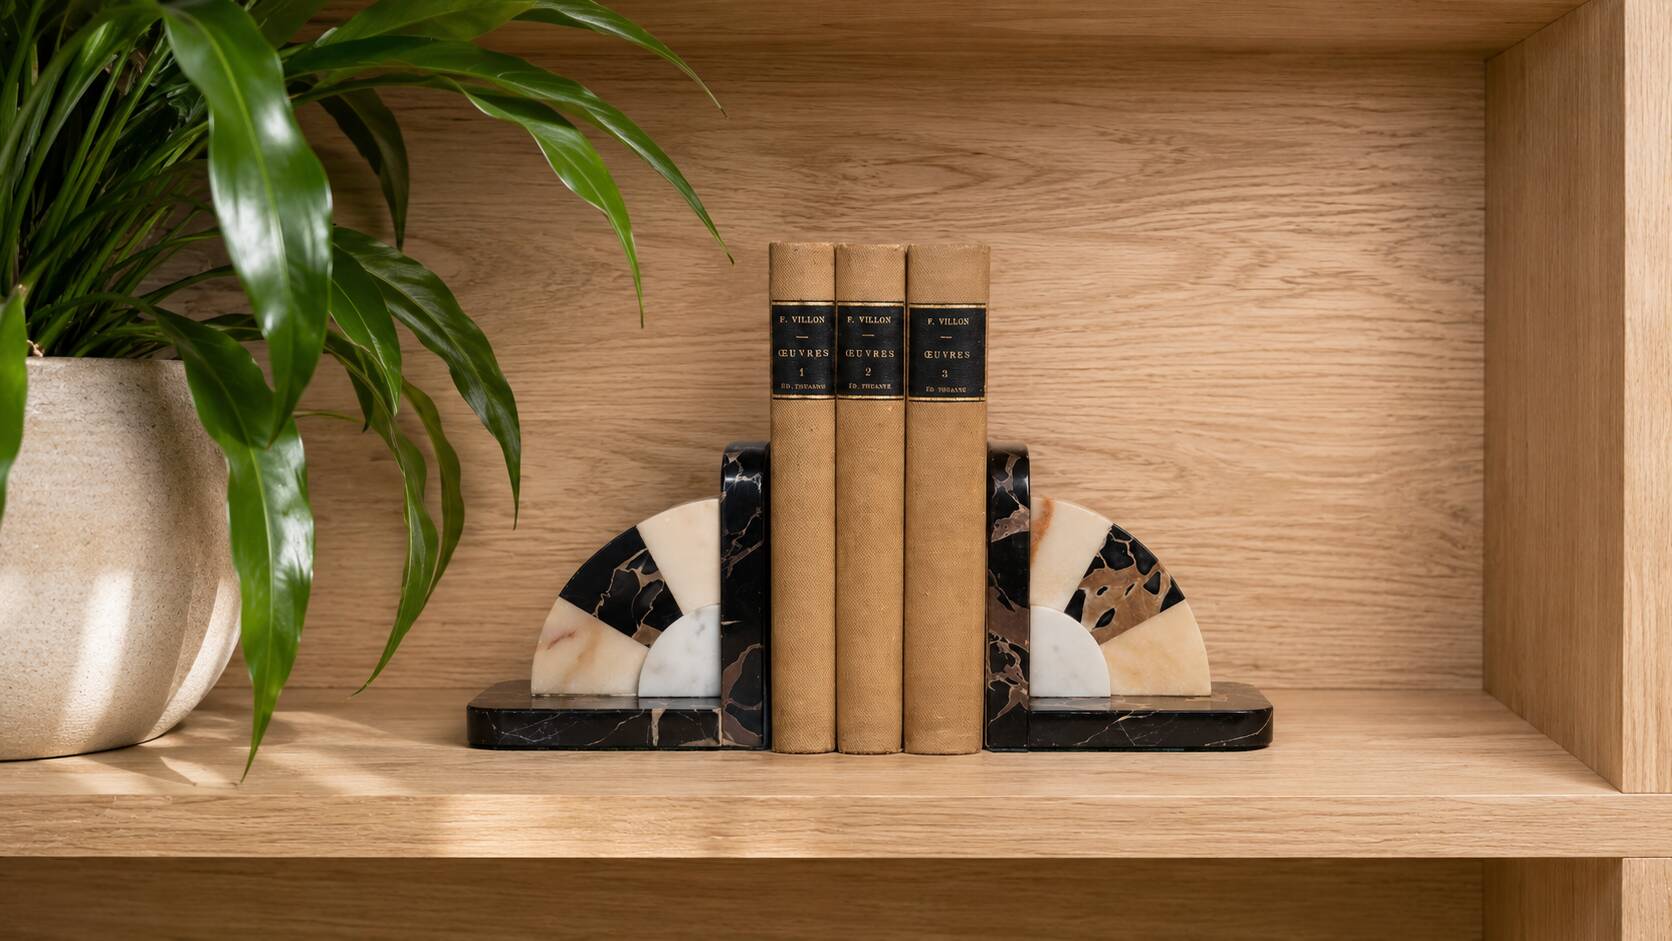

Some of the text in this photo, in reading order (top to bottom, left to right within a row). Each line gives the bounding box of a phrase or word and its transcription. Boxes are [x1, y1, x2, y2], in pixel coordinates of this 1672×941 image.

[780, 315, 825, 324] F. VILLON
[847, 316, 892, 324] F. VILLON
[927, 317, 970, 326] F. VILLON
[778, 348, 829, 358] ŒUVRES
[845, 349, 895, 358] ŒUVRES
[923, 350, 971, 359] ŒUVRES
[799, 367, 804, 377] 1
[865, 367, 872, 377] 2
[941, 369, 948, 378] 3
